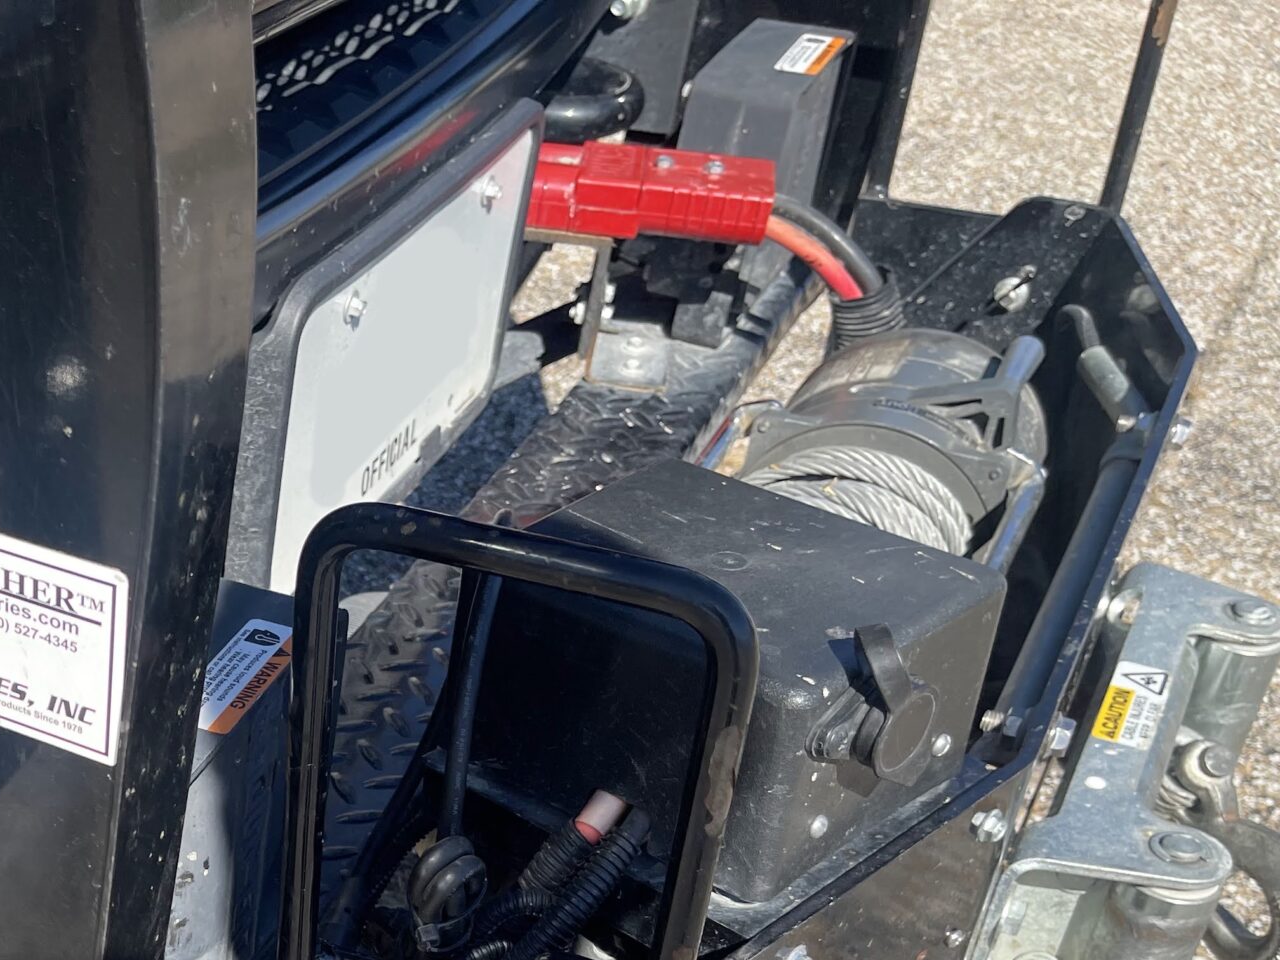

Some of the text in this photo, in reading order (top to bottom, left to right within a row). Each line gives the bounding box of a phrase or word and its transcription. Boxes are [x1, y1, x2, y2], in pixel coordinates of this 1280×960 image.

[361, 418, 417, 497] OFFICIAL
[14, 622, 78, 653] 527-4345
[216, 649, 268, 702] Produces loud sounds
[235, 652, 251, 664] May
[230, 662, 281, 709] WARNING
[33, 710, 60, 727] Since
[62, 719, 84, 735] 1978
[47, 694, 97, 726] INC
[1101, 687, 1132, 730] CAUTION
